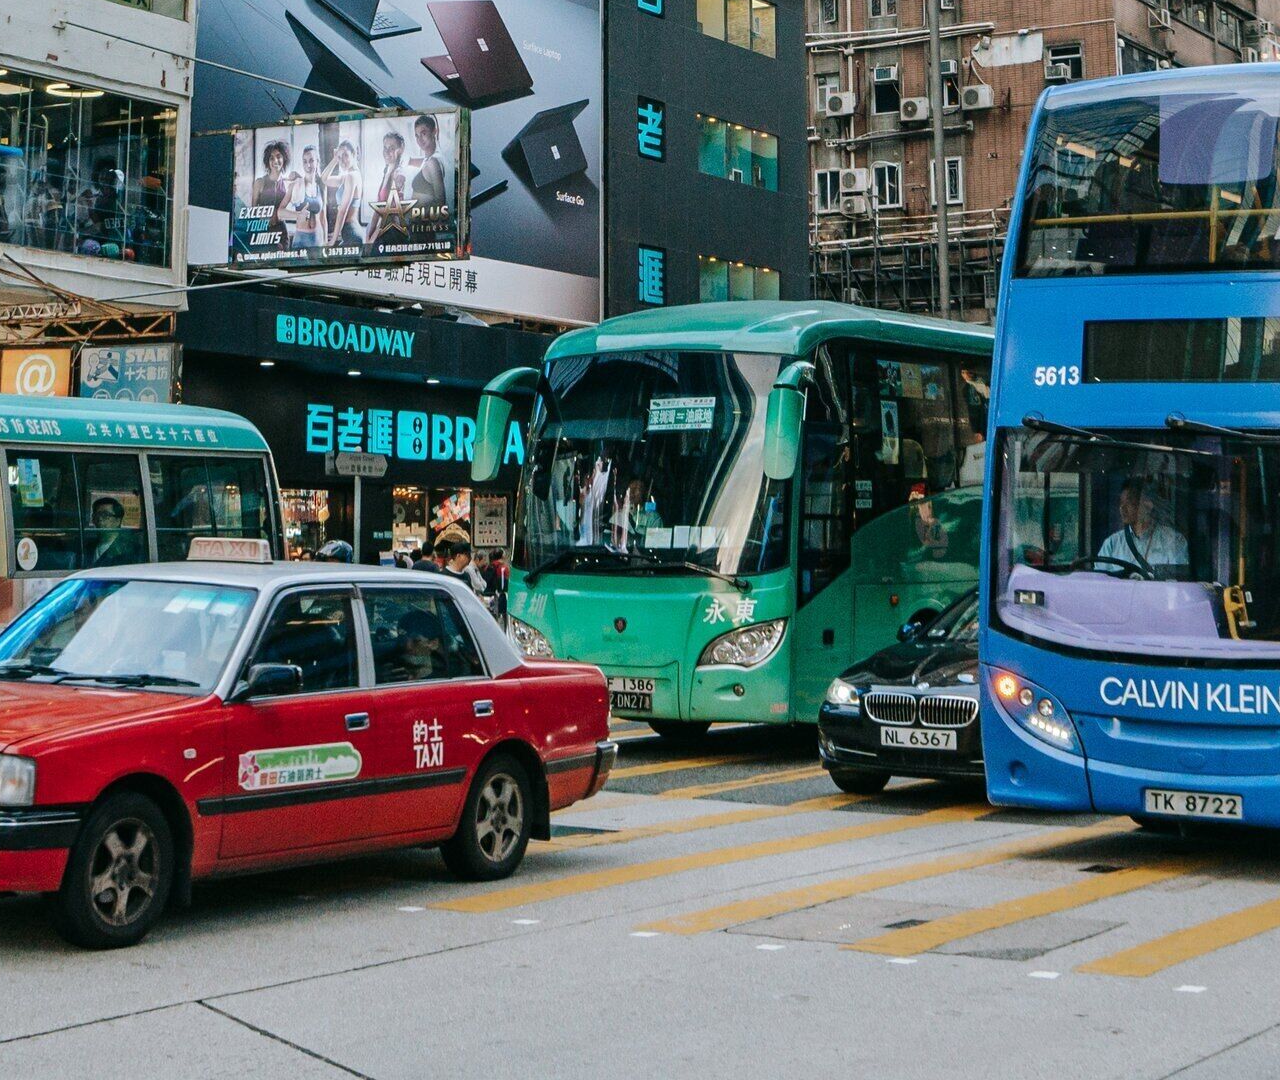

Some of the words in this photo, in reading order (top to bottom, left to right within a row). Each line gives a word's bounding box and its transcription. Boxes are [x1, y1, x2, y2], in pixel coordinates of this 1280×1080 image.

[556, 190, 576, 204] Surface
[576, 195, 585, 207] Go
[238, 204, 275, 219] EXCEED
[411, 205, 449, 220] PLUS
[245, 219, 270, 232] YOUR
[411, 222, 449, 234] fitness
[249, 231, 282, 246] LIMITS
[297, 316, 416, 358] BROADWAY
[125, 347, 169, 363] STAR
[1035, 365, 1080, 386] 5613
[14, 418, 25, 435] 16
[27, 420, 62, 437] SEATS
[432, 414, 525, 466] BRA
[195, 540, 258, 558] TAXI
[703, 598, 758, 624] 永東
[622, 678, 654, 691] 1386
[1099, 676, 1199, 711] CALVIN
[412, 717, 443, 743] 的士
[885, 729, 905, 744] NL
[909, 731, 951, 747] 6367
[413, 741, 444, 769] TAXI
[1151, 792, 1175, 811] TK
[1185, 795, 1238, 816] 8722
